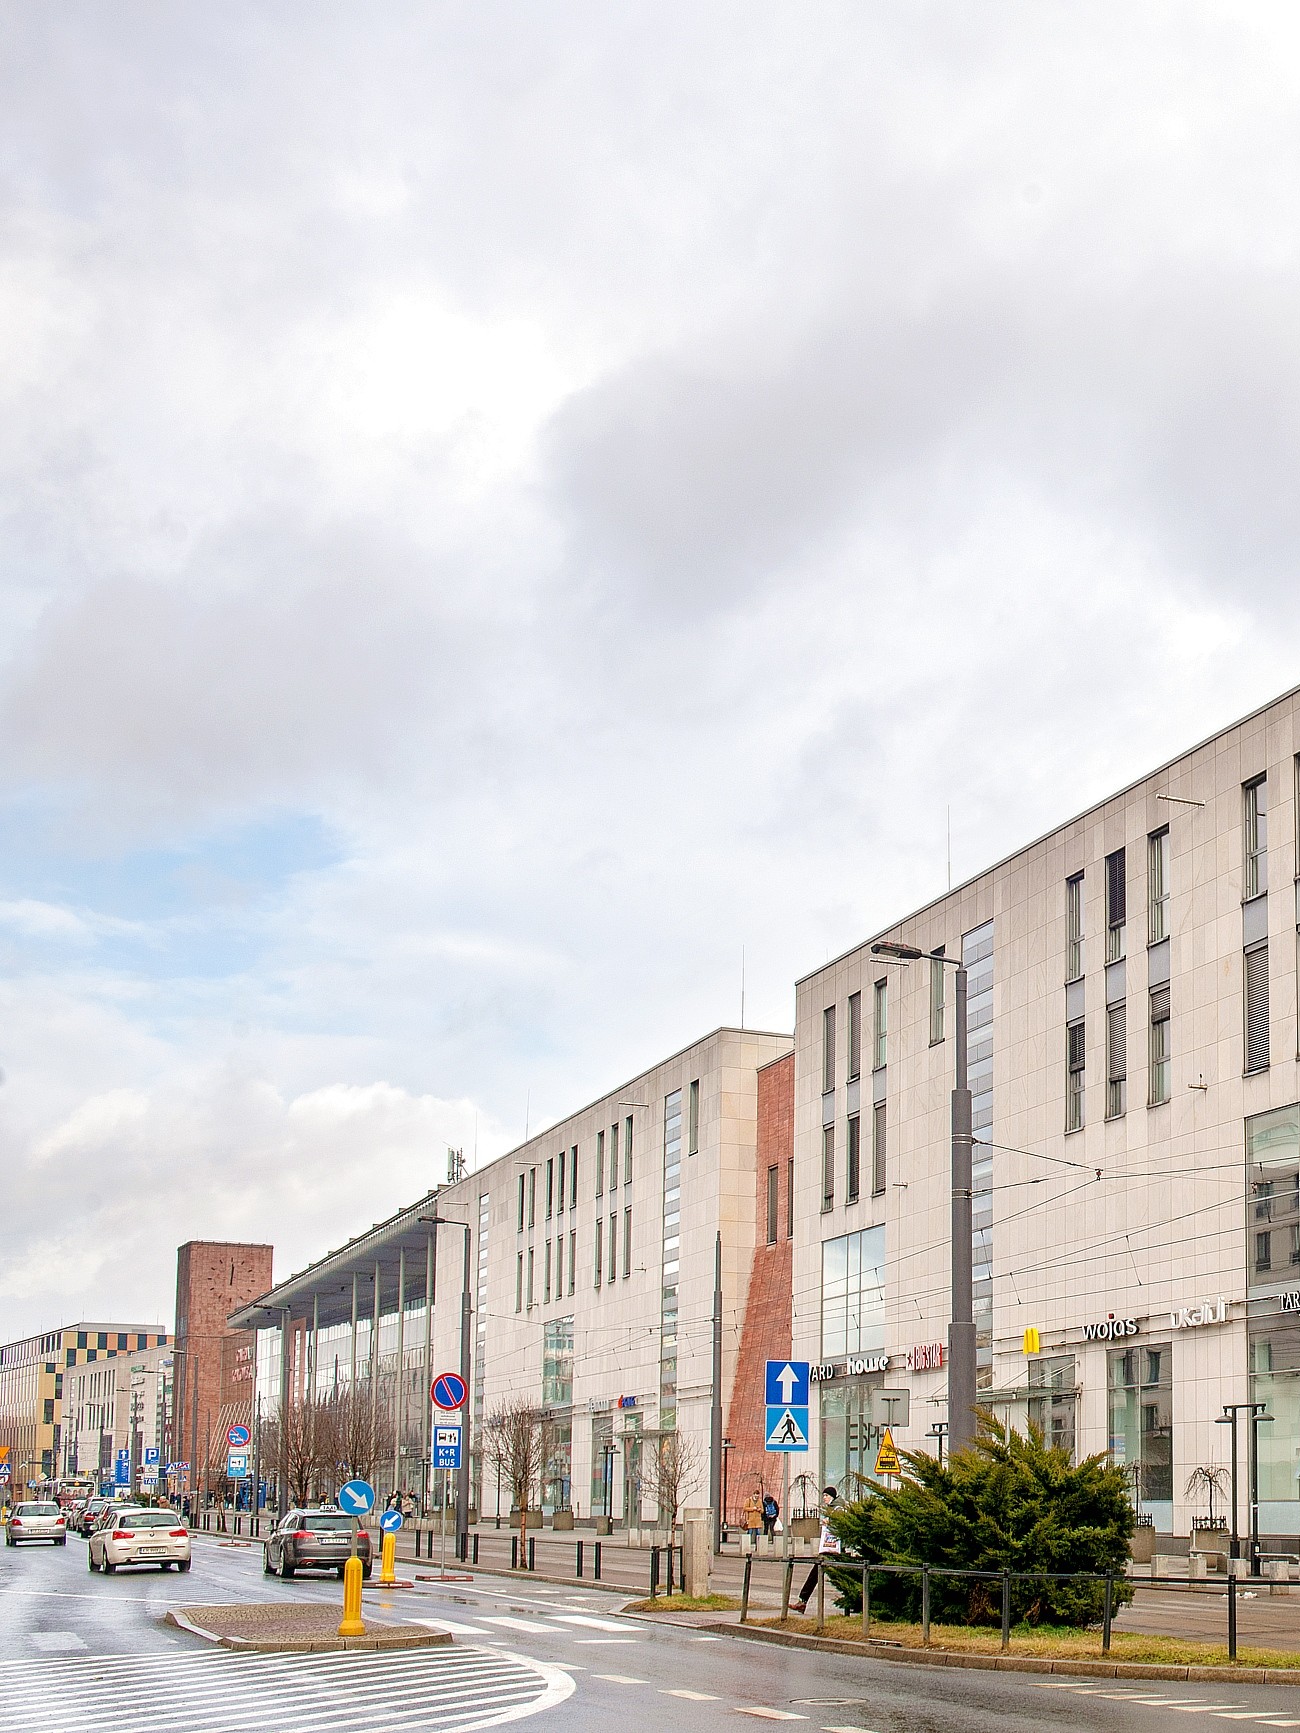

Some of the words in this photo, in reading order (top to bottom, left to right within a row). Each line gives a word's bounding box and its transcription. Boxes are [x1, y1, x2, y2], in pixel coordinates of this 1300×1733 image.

[1082, 1313, 1139, 1340] wojas
[809, 1363, 834, 1382] ARD
[846, 1355, 890, 1375] house
[439, 1458, 455, 1466] BUS
